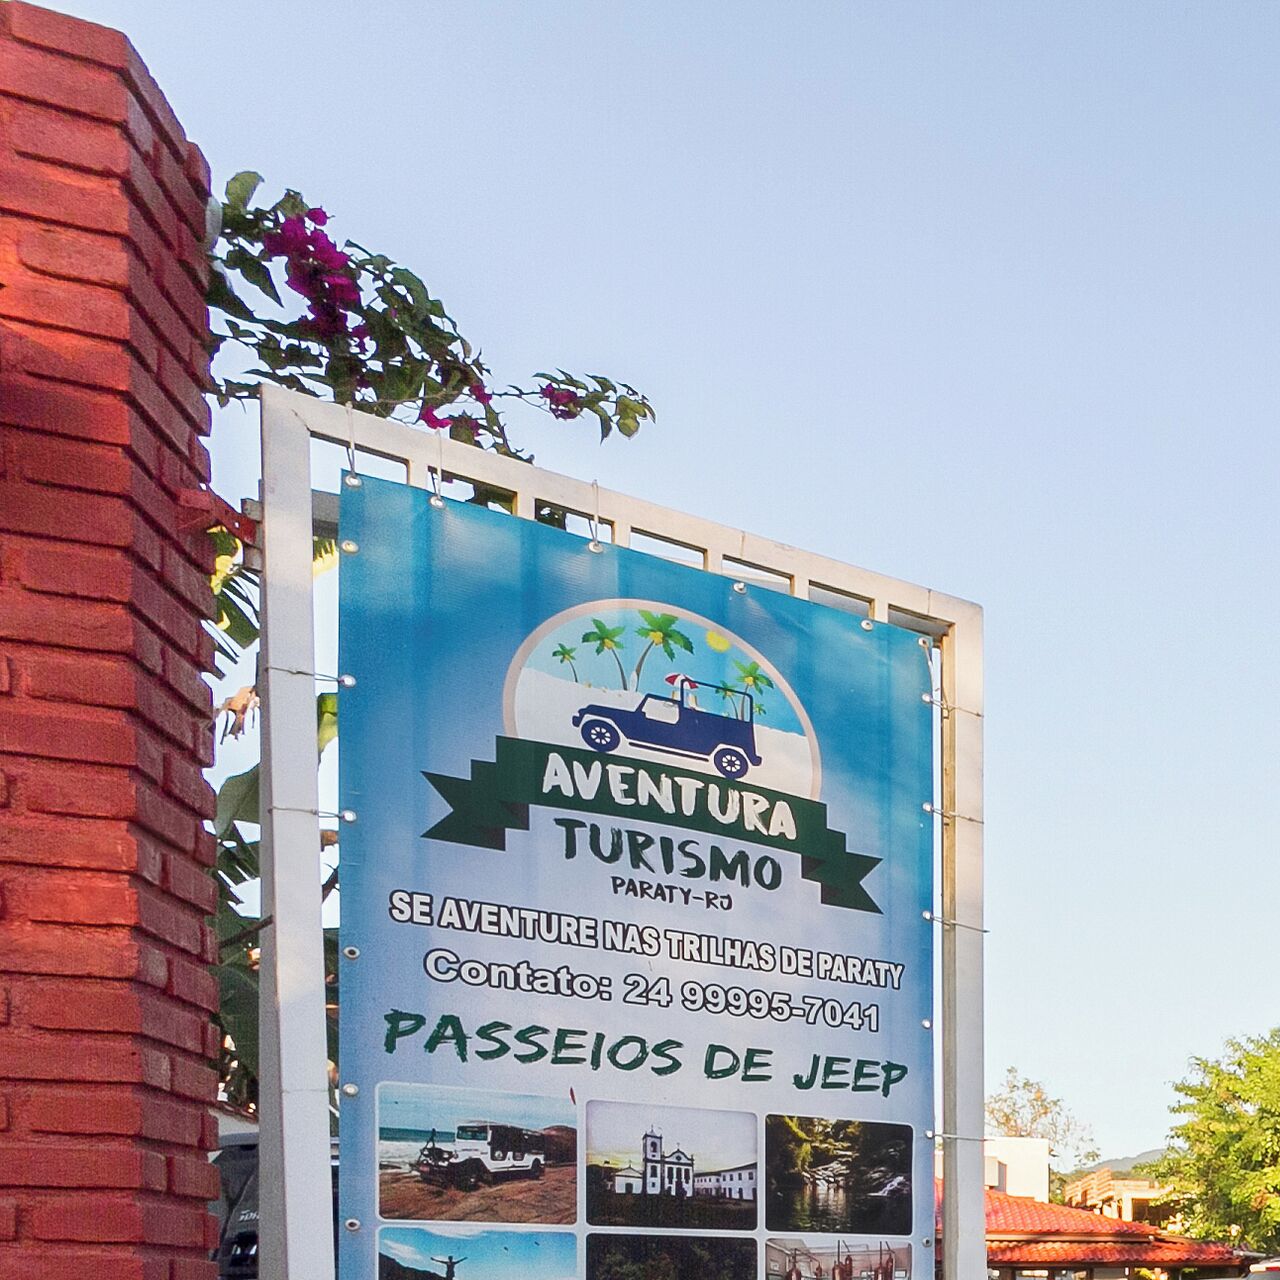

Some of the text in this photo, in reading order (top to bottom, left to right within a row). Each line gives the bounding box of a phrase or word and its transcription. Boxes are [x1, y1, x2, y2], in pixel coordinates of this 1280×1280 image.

[542, 751, 797, 840] AVENTURA
[553, 818, 782, 891] TURISMO
[611, 876, 733, 911] PARATY-RJ
[389, 890, 904, 990] SE AVENTURE NAS TRILHAS DE PARATY
[425, 949, 879, 1032] Contato: 24 99995-7041
[384, 1008, 908, 1098] PASSEIOS DE JEEP
